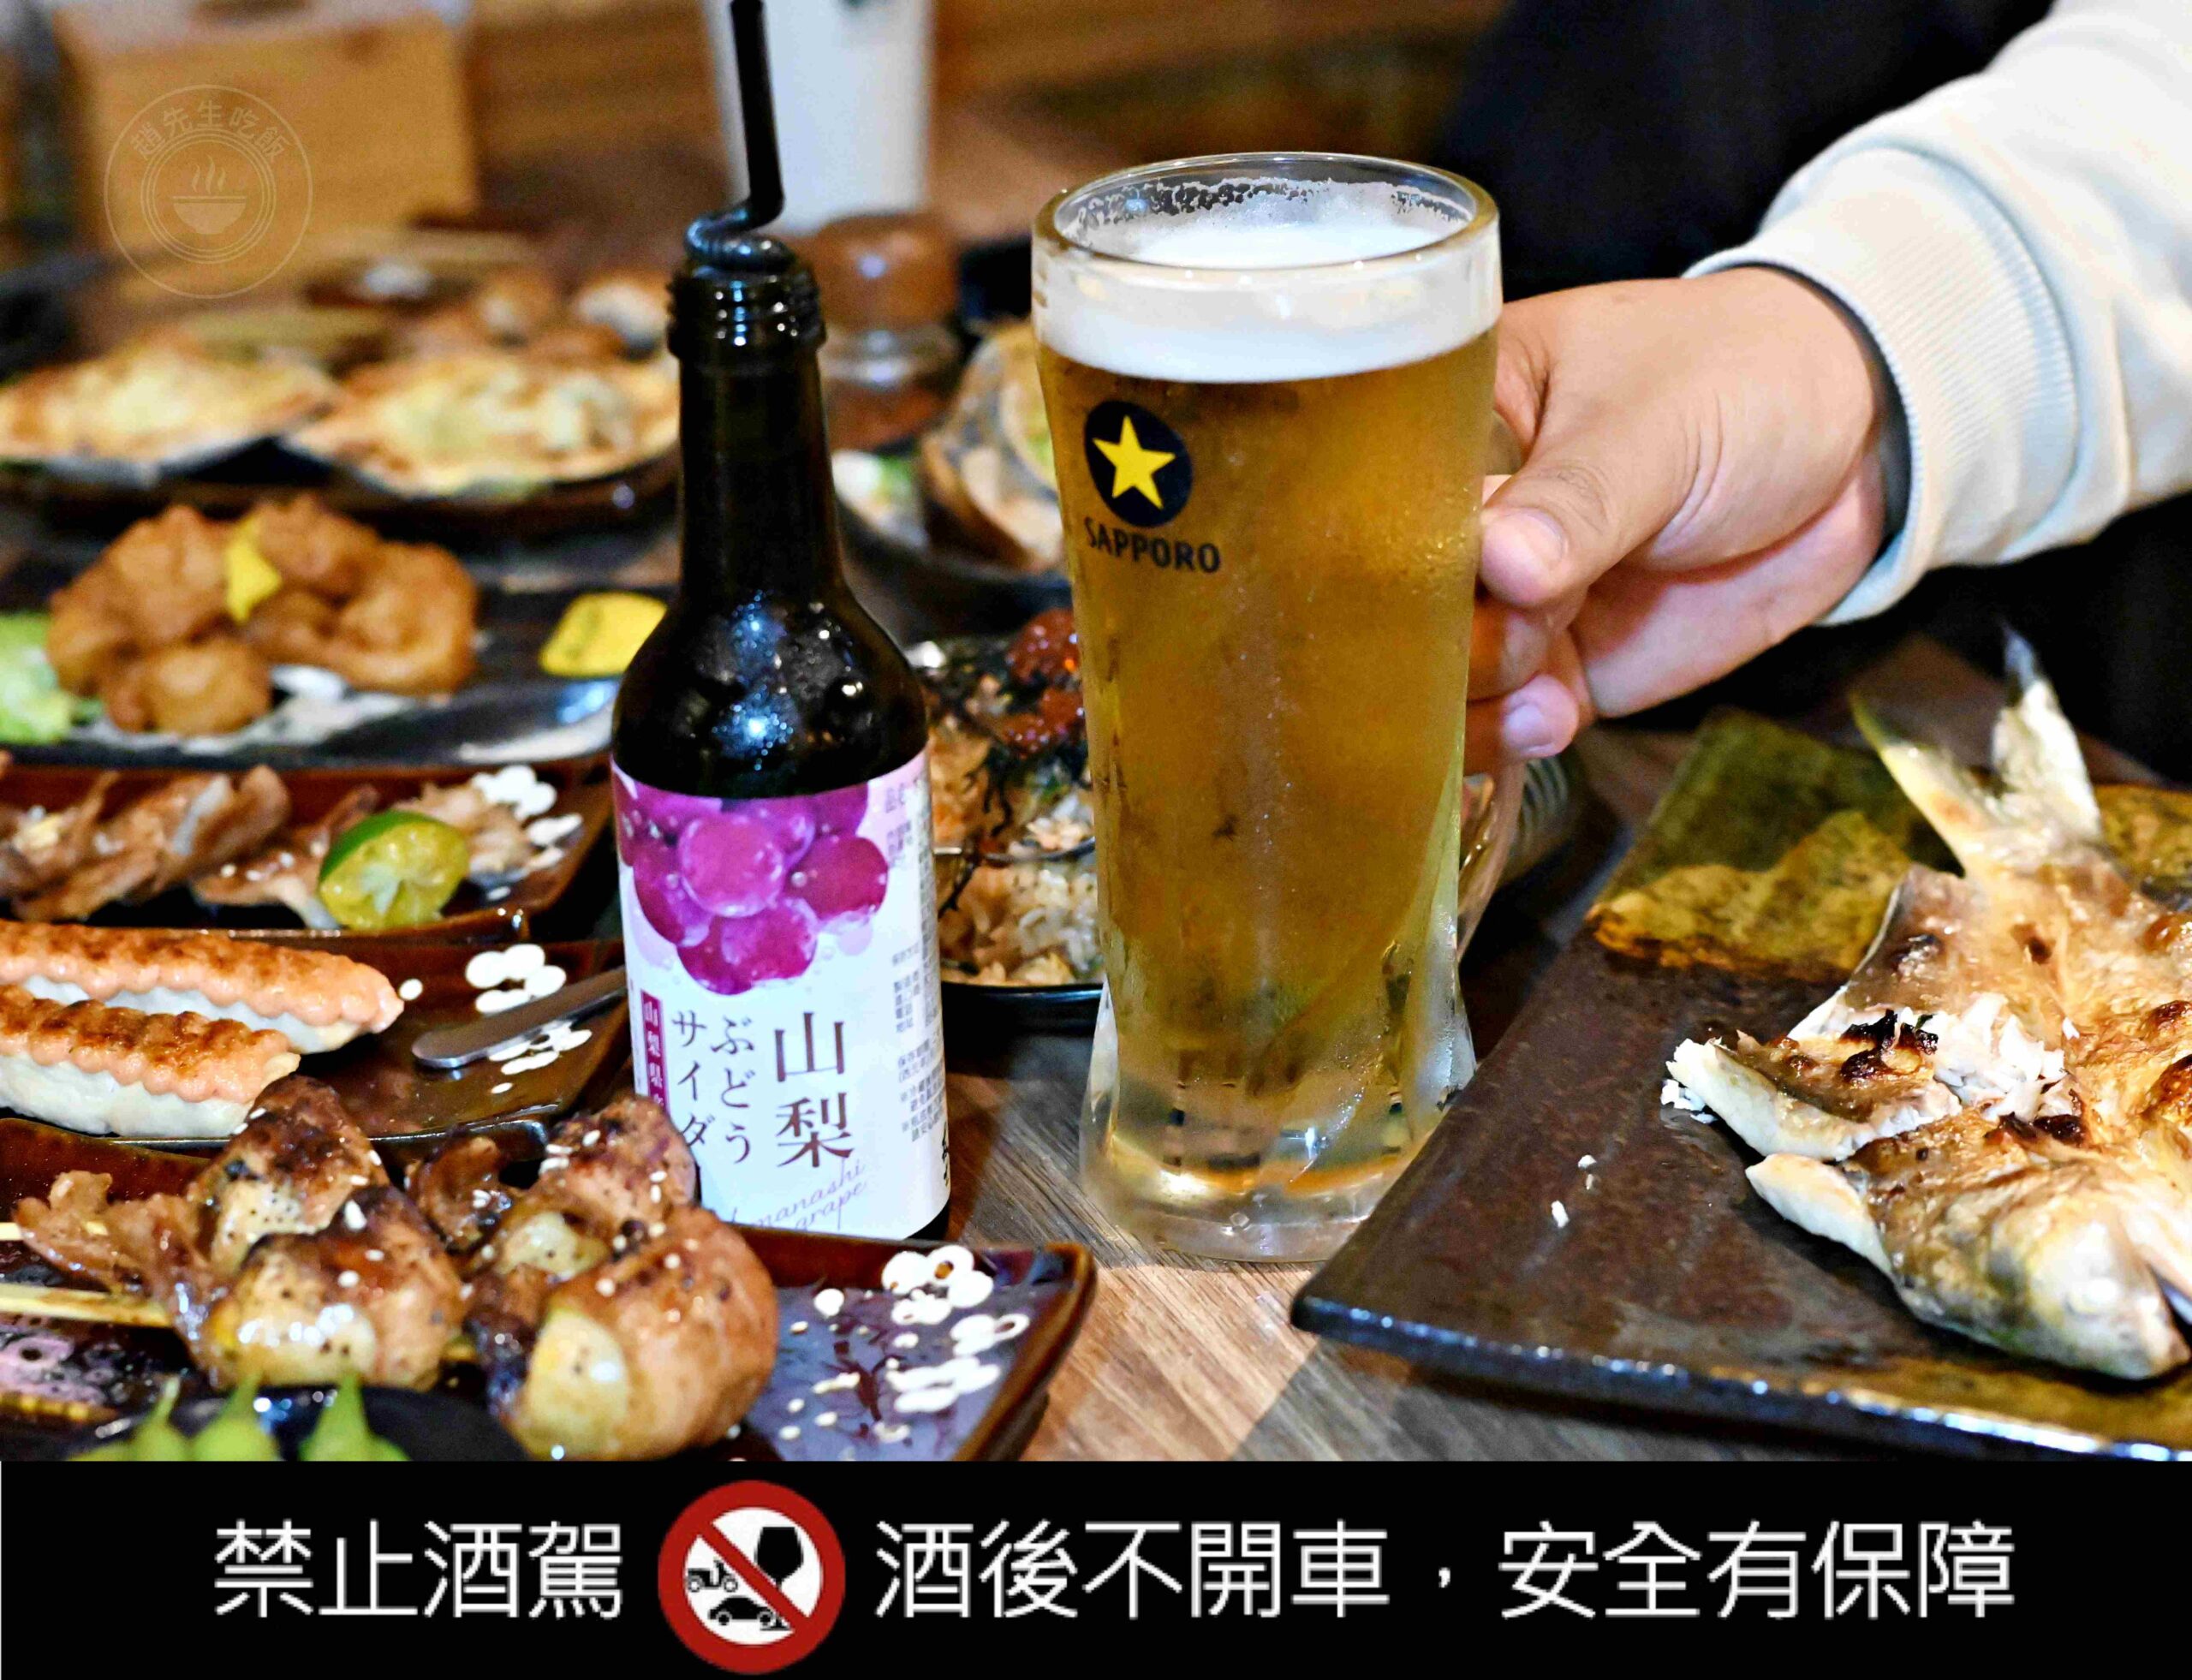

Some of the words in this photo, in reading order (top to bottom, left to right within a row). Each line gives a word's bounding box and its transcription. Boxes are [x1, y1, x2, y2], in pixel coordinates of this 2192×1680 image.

[1084, 516, 1221, 574] SAPPORO
[711, 1016, 755, 1163] ぶどう
[774, 1011, 855, 1168] 山梨
